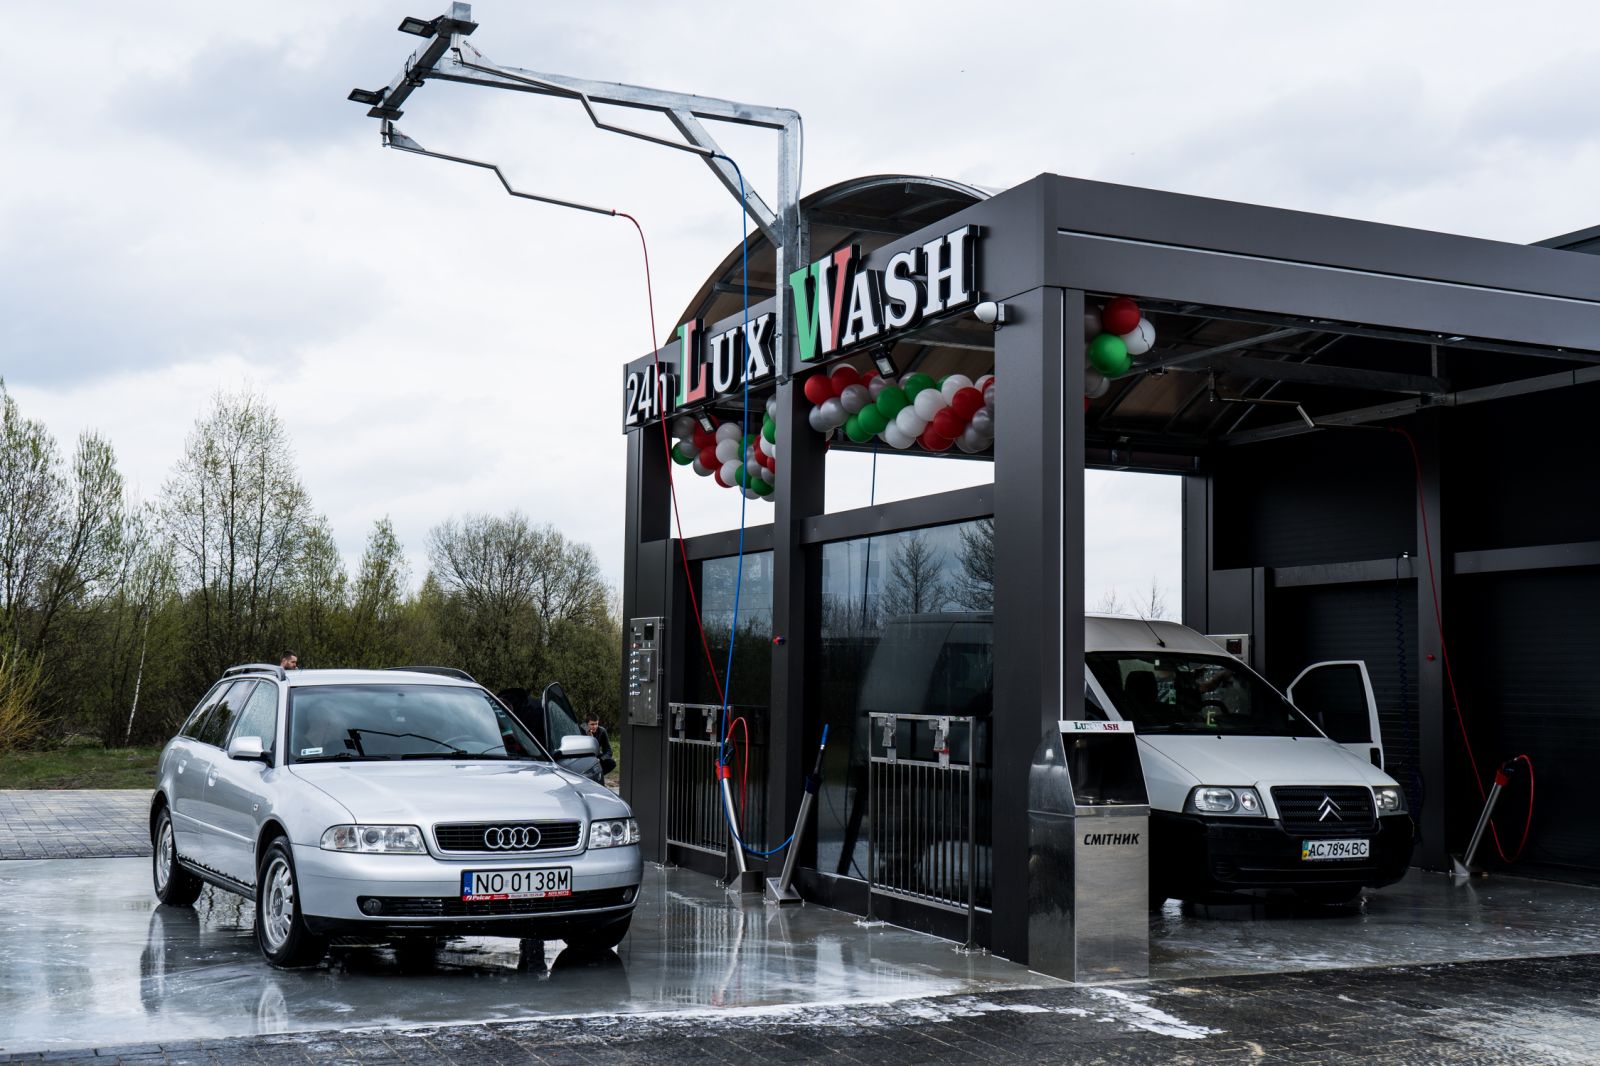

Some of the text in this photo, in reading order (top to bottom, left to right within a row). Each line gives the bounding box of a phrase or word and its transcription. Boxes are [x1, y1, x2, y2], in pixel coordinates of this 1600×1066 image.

[626, 364, 669, 426] 24h
[1084, 833, 1140, 846] СМІТНИК
[1327, 843, 1350, 856] 7894
[1352, 842, 1367, 855] BC
[476, 874, 504, 893] NO
[511, 870, 569, 892] 0138M
